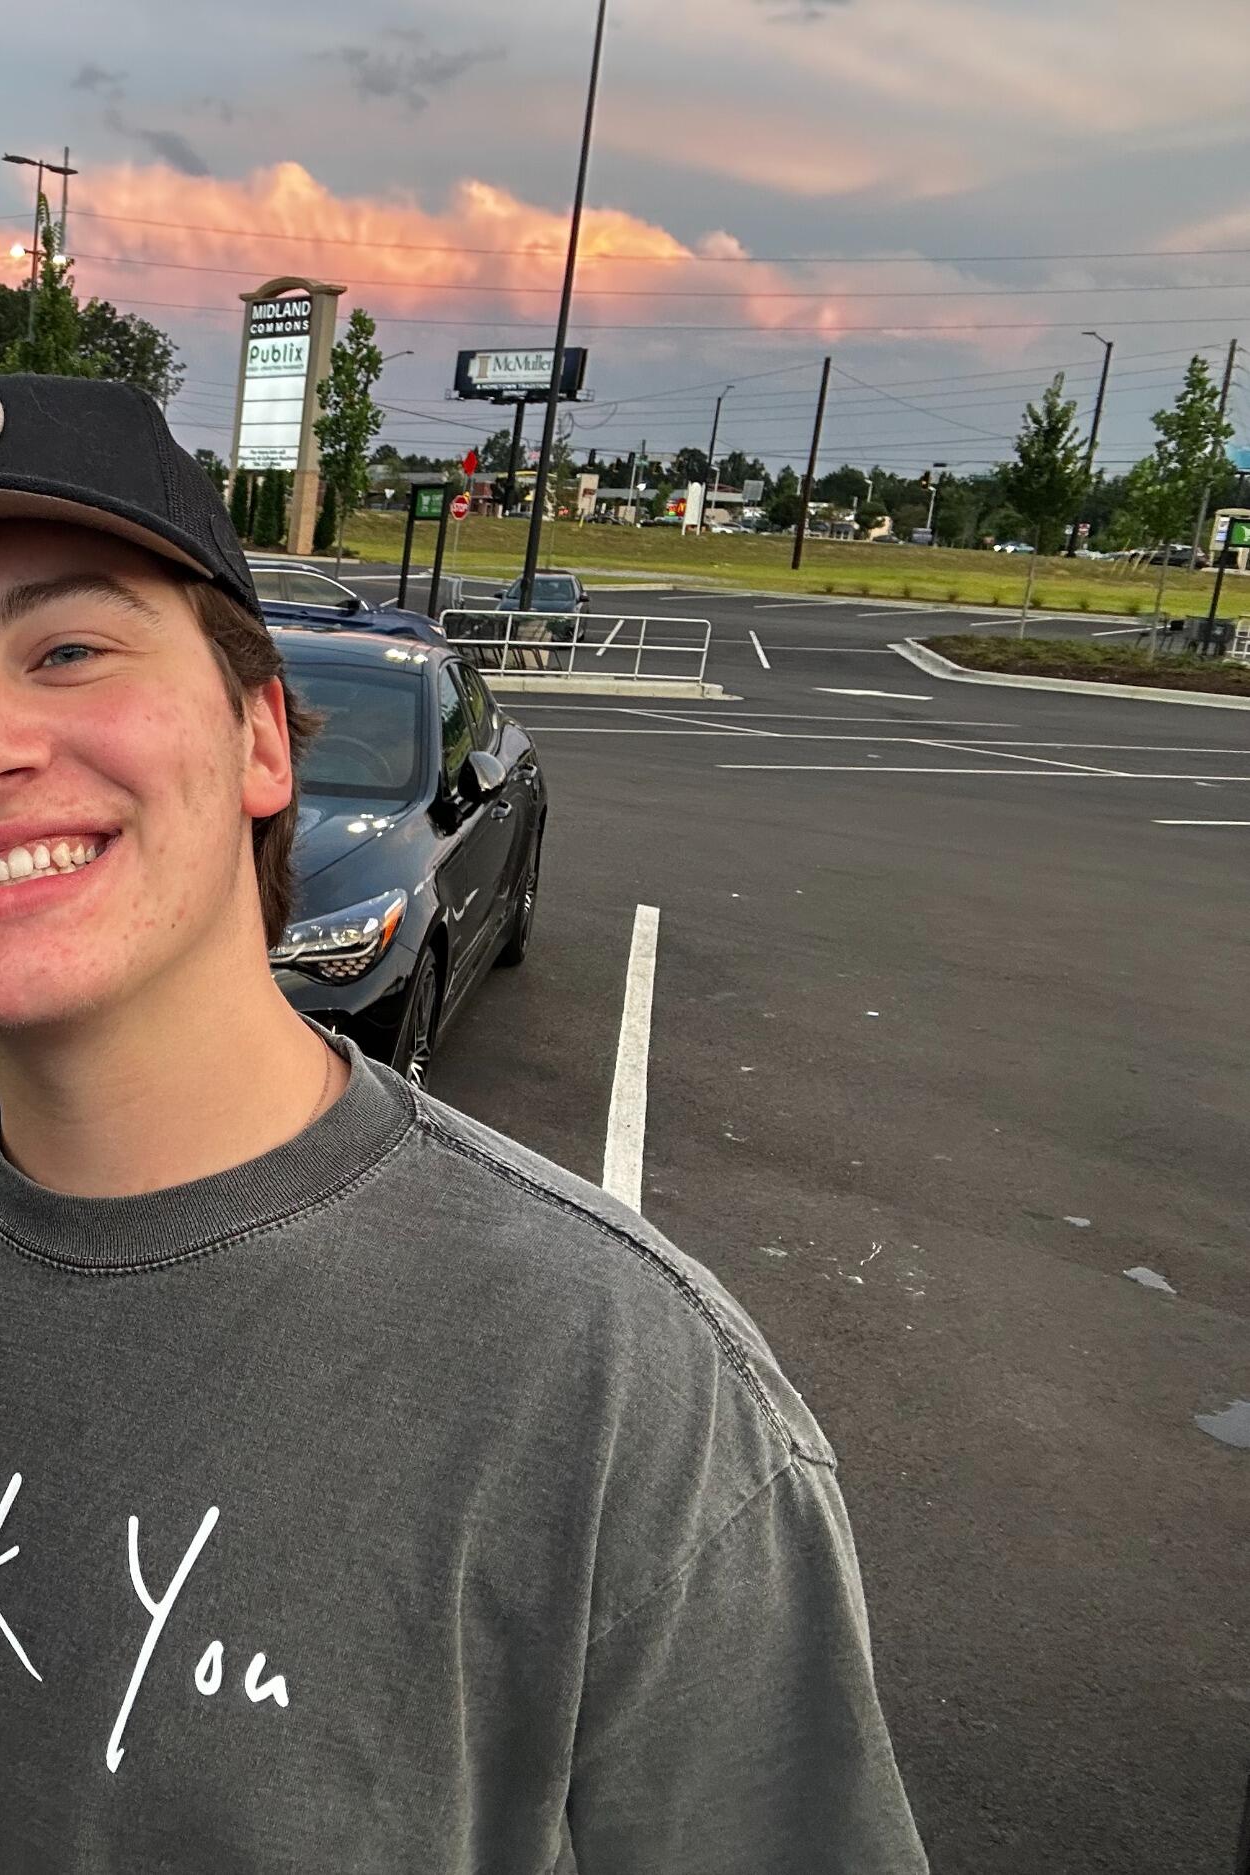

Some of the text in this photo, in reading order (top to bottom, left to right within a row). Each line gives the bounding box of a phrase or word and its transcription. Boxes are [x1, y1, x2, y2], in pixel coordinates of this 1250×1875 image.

[252, 301, 311, 320] MIDLAND
[250, 319, 310, 334] COMMONS
[249, 343, 303, 364] Publix
[452, 502, 468, 512] STOP
[106, 1505, 289, 1773] You
